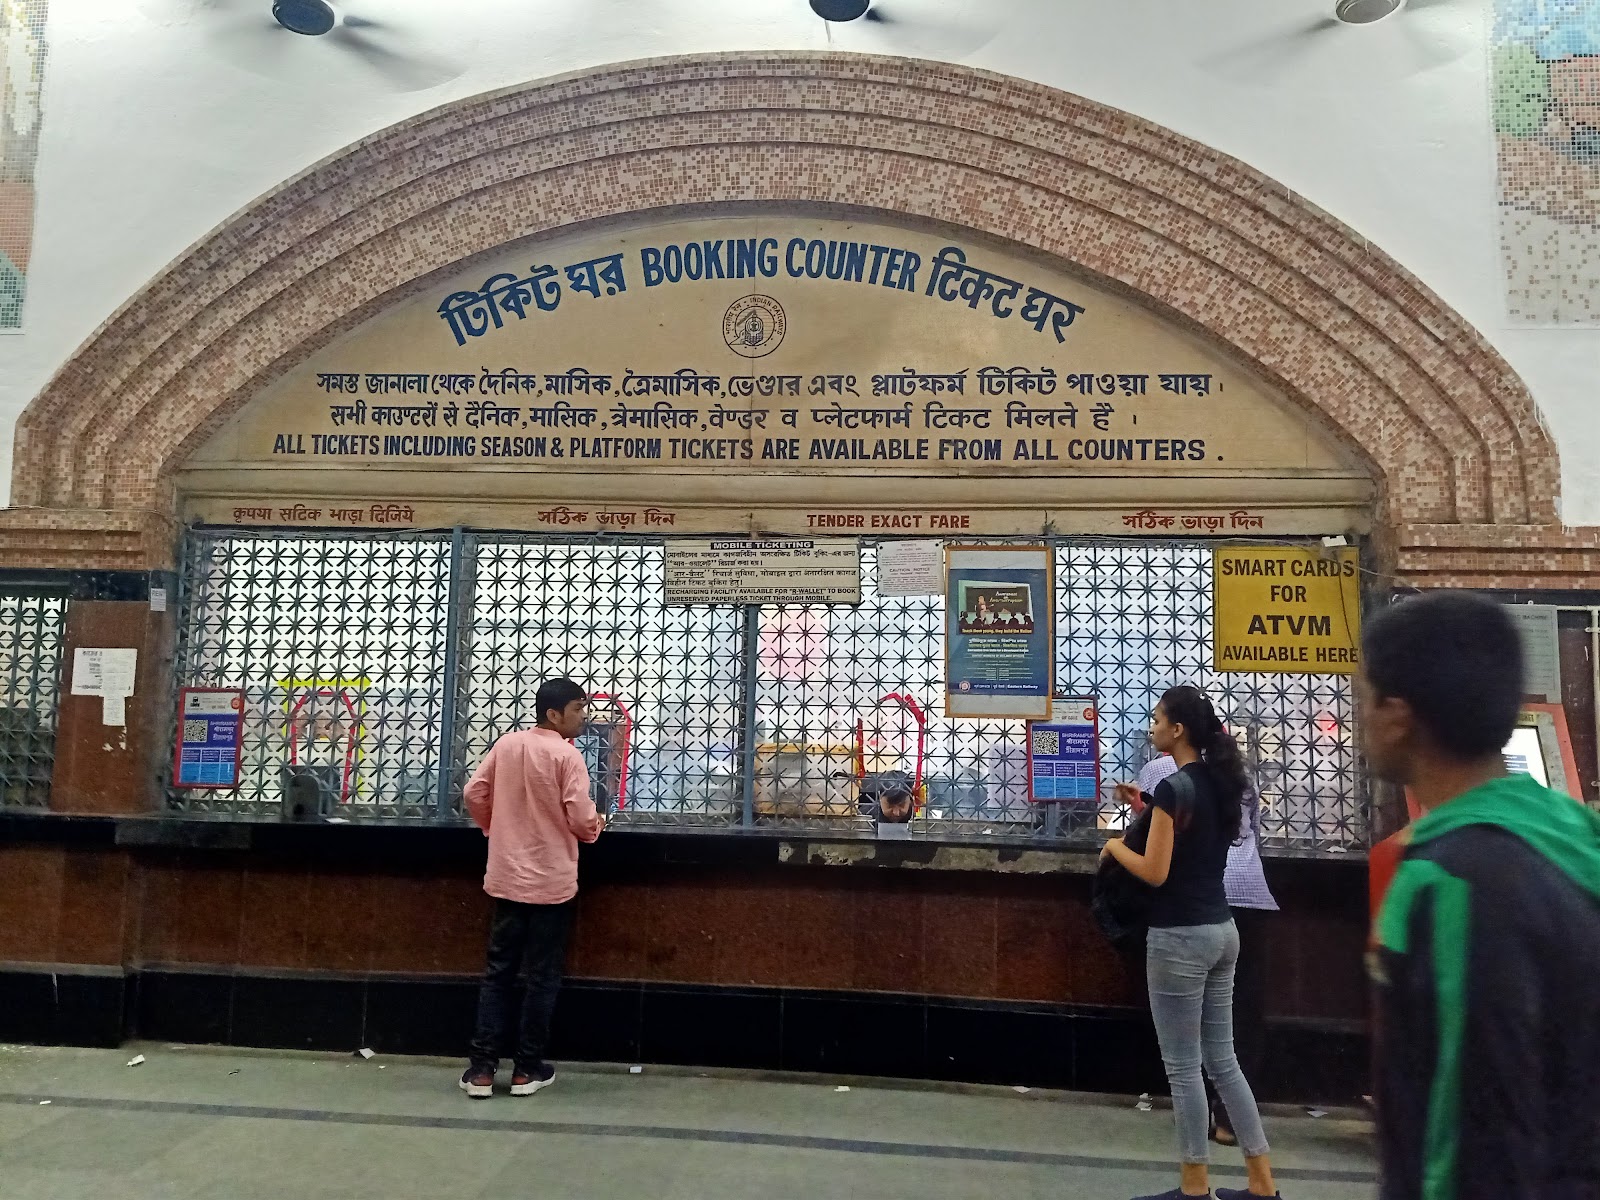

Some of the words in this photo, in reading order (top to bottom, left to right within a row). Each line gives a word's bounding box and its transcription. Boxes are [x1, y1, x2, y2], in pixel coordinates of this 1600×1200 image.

[641, 238, 778, 287] BOOKING
[786, 238, 921, 292] COUNTER
[437, 264, 561, 346] টিকিট
[564, 253, 626, 298] ঘর
[925, 246, 1024, 318] टिकट
[1021, 287, 1085, 343] घर
[749, 298, 773, 307] INDIAN
[771, 305, 784, 336] RAILWAYS
[316, 373, 360, 393] সমস্ত
[365, 374, 430, 394] জানালা
[431, 374, 476, 395] থেকে
[807, 375, 860, 397] এবং
[977, 366, 1057, 395] টিকিট
[1066, 373, 1149, 396] পাওয়া
[330, 399, 367, 426] सभी
[443, 401, 460, 427] से
[780, 409, 798, 428] व
[922, 400, 992, 429] टिकट
[1004, 401, 1079, 429] मिलते
[1089, 402, 1115, 431] है
[272, 434, 306, 454] ALL
[311, 434, 380, 456] TICKETS
[384, 435, 476, 457] INCLUDING
[481, 436, 546, 458] SEASON
[550, 437, 564, 458] &
[570, 437, 661, 459] PLATFORM
[668, 438, 753, 460] TICKETS
[761, 438, 799, 460] ARE
[808, 438, 929, 460] AVAILABLE
[938, 439, 1002, 460] FROM
[1013, 439, 1061, 460] ALL
[233, 507, 272, 523] कृपया
[537, 506, 588, 525] সঠিক
[596, 511, 636, 529] ভাড়া
[643, 508, 676, 526] দিন
[806, 514, 865, 528] TENDER
[871, 514, 923, 528] EXACT
[930, 515, 970, 528] FARE
[1121, 510, 1176, 529] সঠিক
[1180, 515, 1225, 533] ভাড়া
[1229, 510, 1264, 529] দিন
[794, 549, 811, 557] টিকিট
[1222, 558, 1287, 576] SMART
[1290, 559, 1355, 577] CARDS
[1270, 585, 1307, 602] FOR
[1247, 614, 1331, 636] ATVM
[1222, 645, 1308, 662] AVAILABLE
[1316, 647, 1359, 662] HERE
